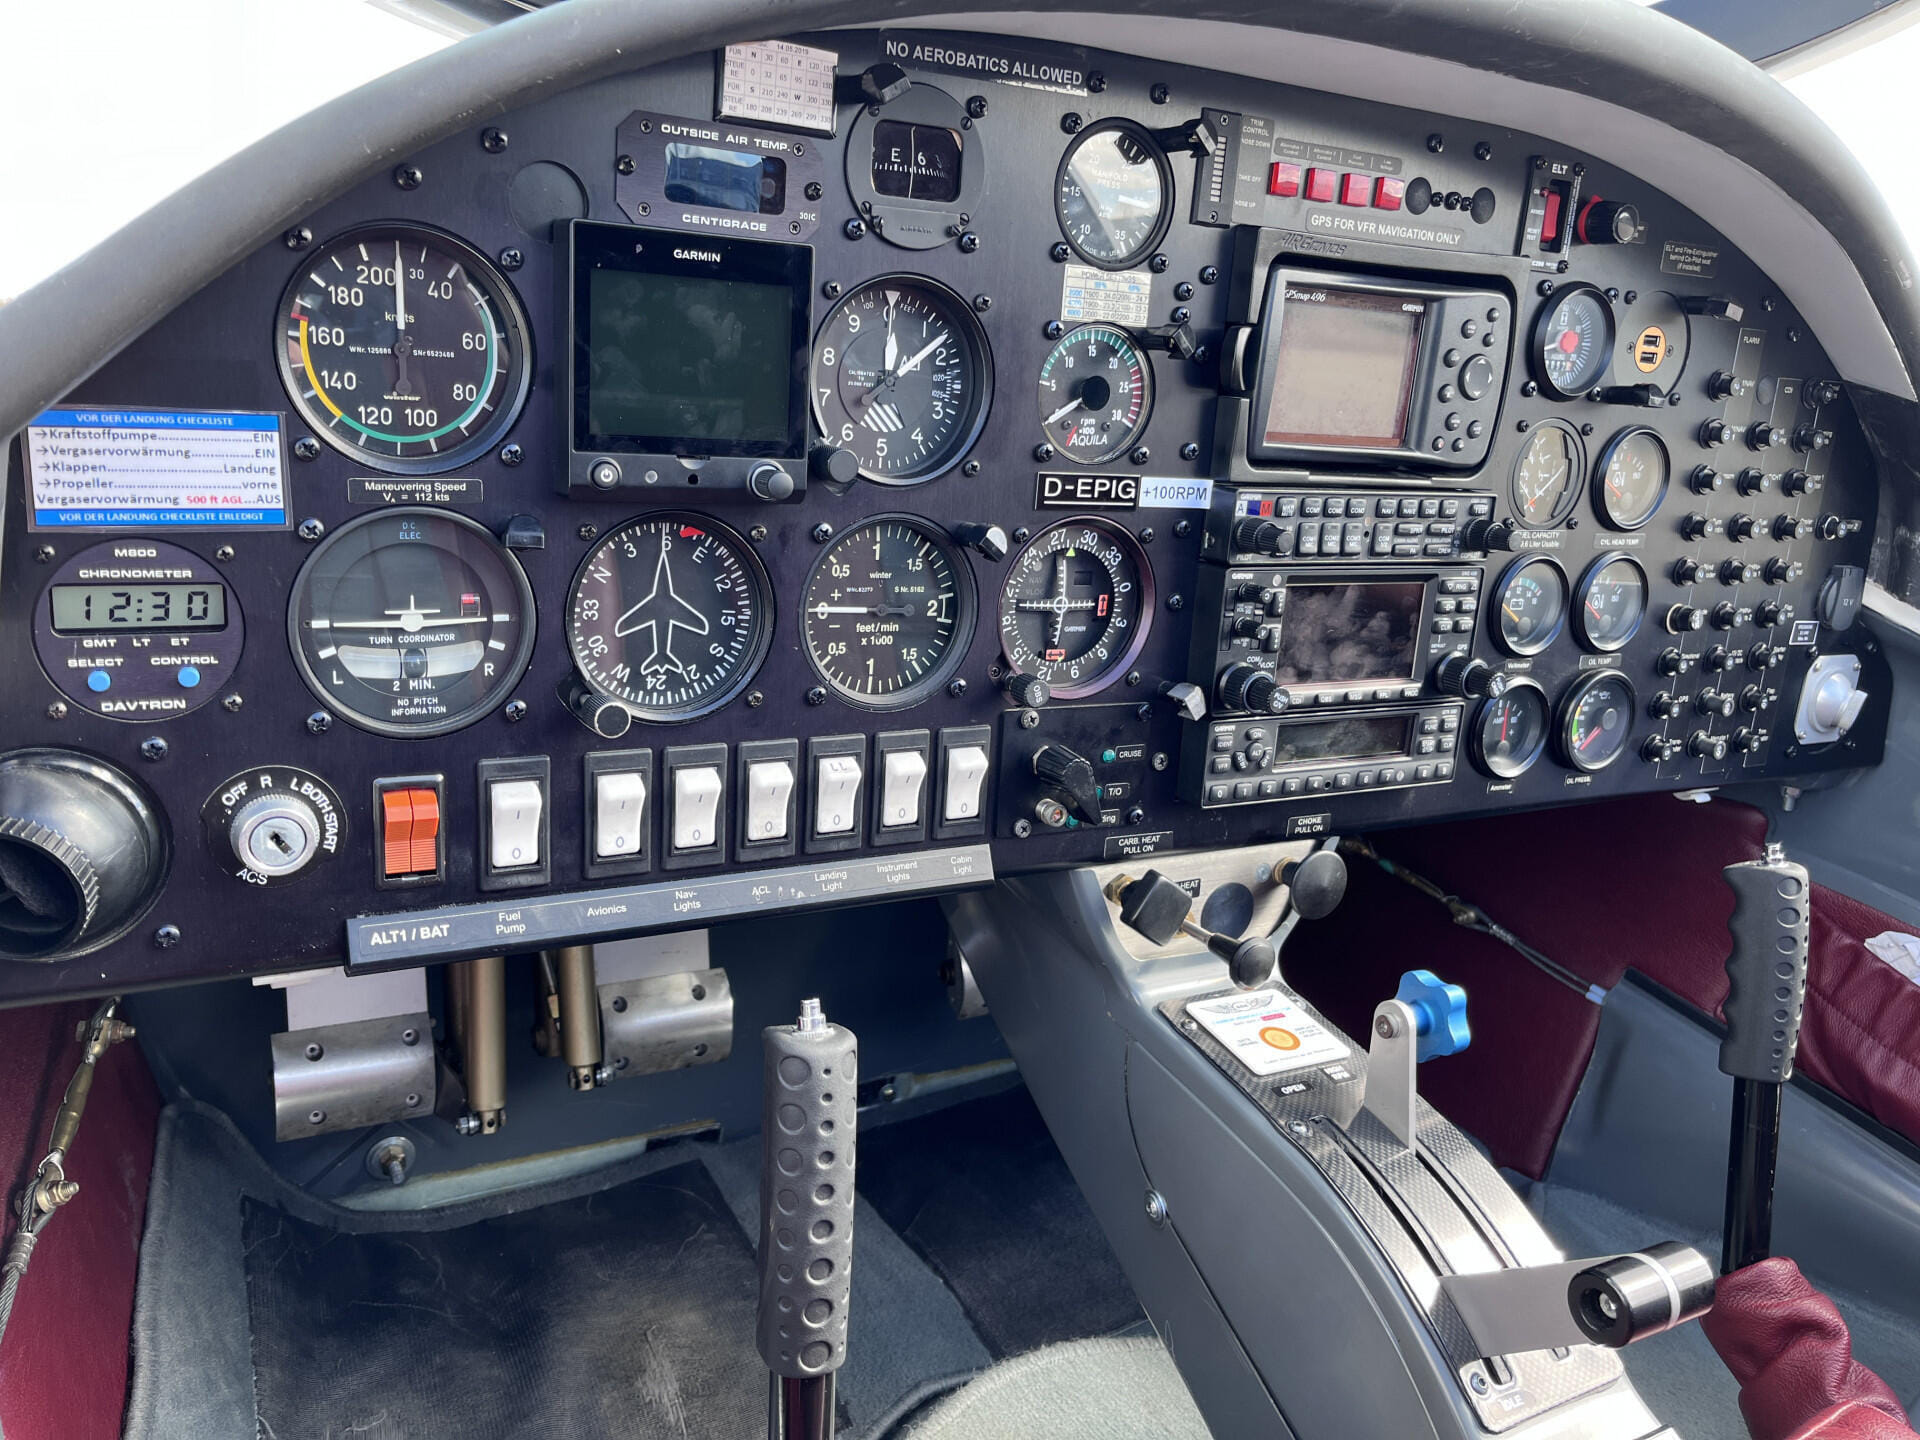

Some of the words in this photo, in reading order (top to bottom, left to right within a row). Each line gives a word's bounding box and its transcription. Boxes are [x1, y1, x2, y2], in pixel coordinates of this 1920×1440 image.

[886, 41, 908, 57] NO
[913, 45, 1009, 73] AEROBATICS
[1012, 61, 1082, 85] ALLOWED
[1251, 119, 1264, 127] TRIM
[1243, 126, 1269, 136] CONTROL
[661, 124, 719, 141] OUTSIDE
[726, 134, 748, 145] AIR
[754, 139, 790, 152] TEMP.
[891, 148, 900, 162] E
[918, 152, 926, 165] 6
[1552, 163, 1568, 175] ELT
[1070, 186, 1080, 196] 15
[682, 214, 767, 231] CENTIGRADE
[1080, 224, 1090, 234] 10
[1311, 215, 1331, 228] GPS
[1334, 218, 1354, 230] FOR
[1357, 221, 1376, 233] VFR
[1378, 224, 1434, 242] NAVIGATION
[1436, 232, 1461, 244] ONLY
[674, 249, 721, 263] GARMIN
[357, 266, 396, 285] 200
[410, 269, 424, 280] 30
[328, 287, 363, 306] 180
[428, 282, 452, 299] 40
[1311, 292, 1326, 302] 496
[385, 312, 414, 323] knts
[849, 315, 860, 332] 9
[309, 326, 344, 346] 160
[462, 334, 486, 350] 60
[823, 348, 835, 365] 8
[936, 348, 946, 366] 2
[1088, 346, 1096, 356] 15
[1065, 357, 1074, 368] 10
[1109, 358, 1118, 368] 20
[321, 371, 356, 390] 140
[453, 385, 476, 401] 80
[1119, 382, 1128, 392] 25
[76, 414, 98, 423] VOR
[101, 414, 122, 424] DER
[124, 415, 173, 425] LANDUNG
[175, 416, 233, 426] CHECKLISTE
[358, 406, 392, 425] 120
[405, 409, 437, 426] 100
[1112, 410, 1121, 420] 30
[1080, 418, 1095, 426] rpm
[254, 433, 273, 443] EIN
[1069, 435, 1108, 446] AQUILA
[255, 449, 275, 458] EIN
[365, 482, 431, 492] Maneuvering
[434, 483, 466, 493] Speed
[1044, 478, 1136, 499] D-EPIG
[1143, 486, 1207, 500] +100RPM
[37, 493, 179, 506] Vergaservorwärmung
[187, 496, 207, 504] 500
[210, 495, 218, 504] ft
[435, 493, 450, 501] kts
[59, 513, 82, 521] VOR
[84, 513, 105, 521] DER
[107, 513, 158, 521] LANDUNG
[160, 512, 216, 521] CHECKLISTE
[219, 512, 264, 521] ERLEDIGT
[400, 532, 421, 540] ELEC
[1050, 529, 1066, 545] 27
[1081, 530, 1098, 545] 30
[115, 549, 157, 557] M800
[692, 546, 708, 563] E
[873, 543, 880, 560] 1
[907, 559, 922, 571] 1,5
[79, 570, 192, 578] CHRONOMETER
[593, 567, 612, 584] N
[832, 565, 850, 578] 0,5
[85, 591, 208, 622] 12:30
[927, 600, 937, 616] 2
[856, 622, 899, 632] feet/min
[83, 639, 117, 648] GMT
[133, 639, 151, 647] LT
[369, 636, 392, 645] TURN
[398, 633, 455, 643] COORDINATOR
[870, 635, 893, 645] 1000
[68, 658, 123, 667] SELECT
[151, 657, 219, 665] CONTROL
[393, 681, 400, 692] 2
[410, 679, 435, 690] MIN.
[101, 700, 186, 712] DAVTRON
[414, 697, 438, 705] PITCH
[392, 707, 446, 716] INFORMATION
[1119, 750, 1142, 758] CRUISE
[260, 775, 273, 789] R
[290, 777, 299, 791] L
[222, 782, 248, 806] OFF
[300, 781, 333, 814] BOTH
[1298, 817, 1322, 825] CHOKE
[323, 813, 339, 853] START
[1119, 838, 1138, 846] CARB.
[1141, 836, 1160, 844] HEAT
[1124, 846, 1140, 854] PULL
[950, 855, 972, 864] Cabin
[877, 861, 918, 873] Instrument
[953, 864, 972, 875] Light
[236, 868, 268, 885] ACS
[815, 871, 847, 883] Landing
[887, 871, 910, 883] Lights
[752, 886, 771, 896] ACL
[822, 881, 842, 893] Light
[676, 890, 697, 900] Nav-
[587, 904, 627, 917] Avionics
[674, 899, 701, 911] Lights
[499, 911, 521, 922] Fuel
[371, 930, 407, 946] ALT1
[412, 929, 417, 941] /
[420, 924, 450, 939] BAT
[496, 923, 526, 935] Pump
